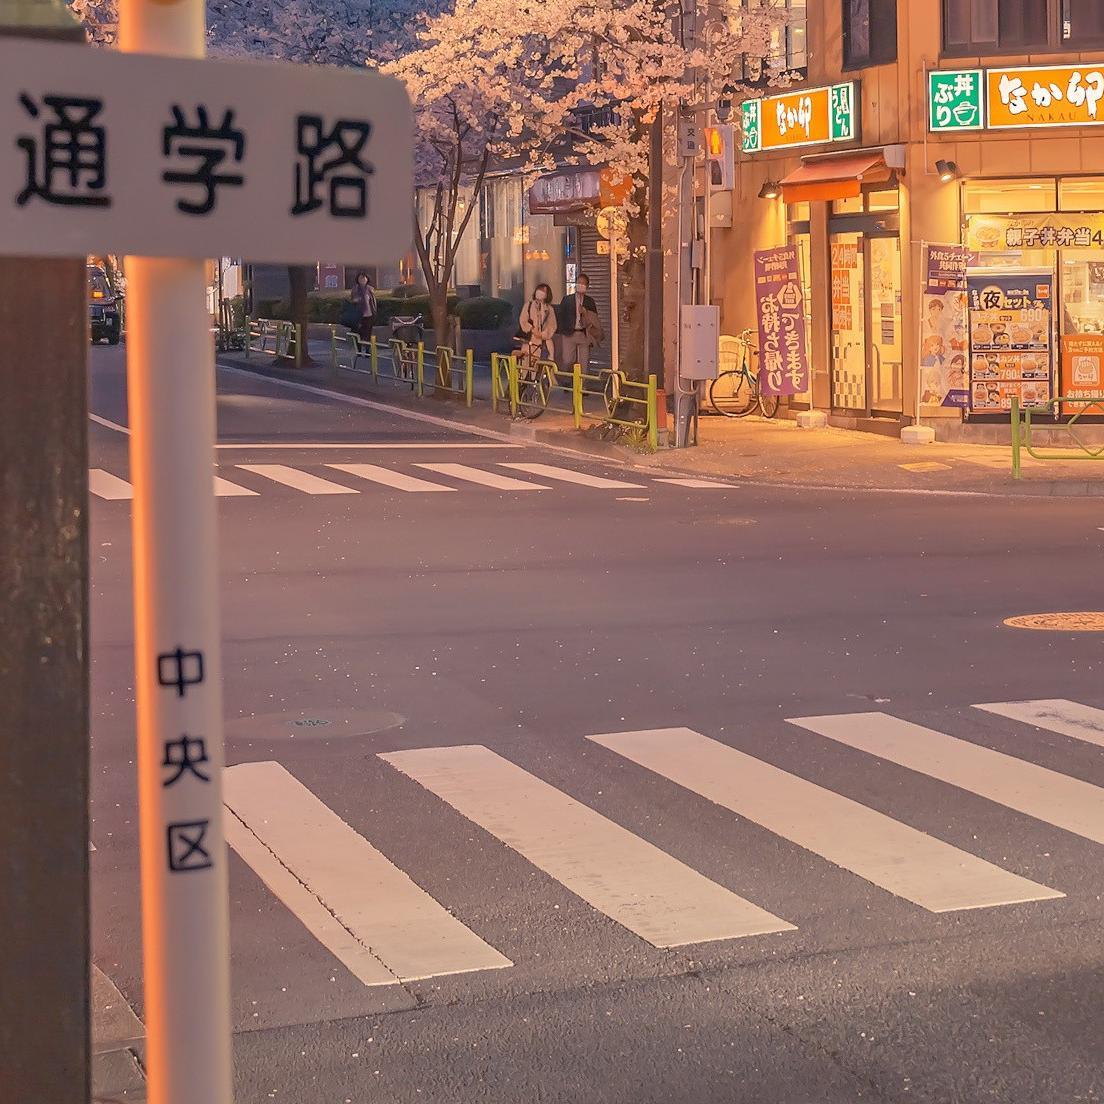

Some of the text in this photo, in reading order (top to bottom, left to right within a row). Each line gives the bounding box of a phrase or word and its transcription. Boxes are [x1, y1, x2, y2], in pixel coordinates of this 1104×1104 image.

[776, 96, 812, 138] なか卯
[998, 70, 1104, 121] なか卯
[15, 92, 374, 217] 通学路
[1005, 227, 1092, 247] 親子丼弁当
[983, 290, 1001, 309] 夜
[157, 647, 214, 873] 中央区
